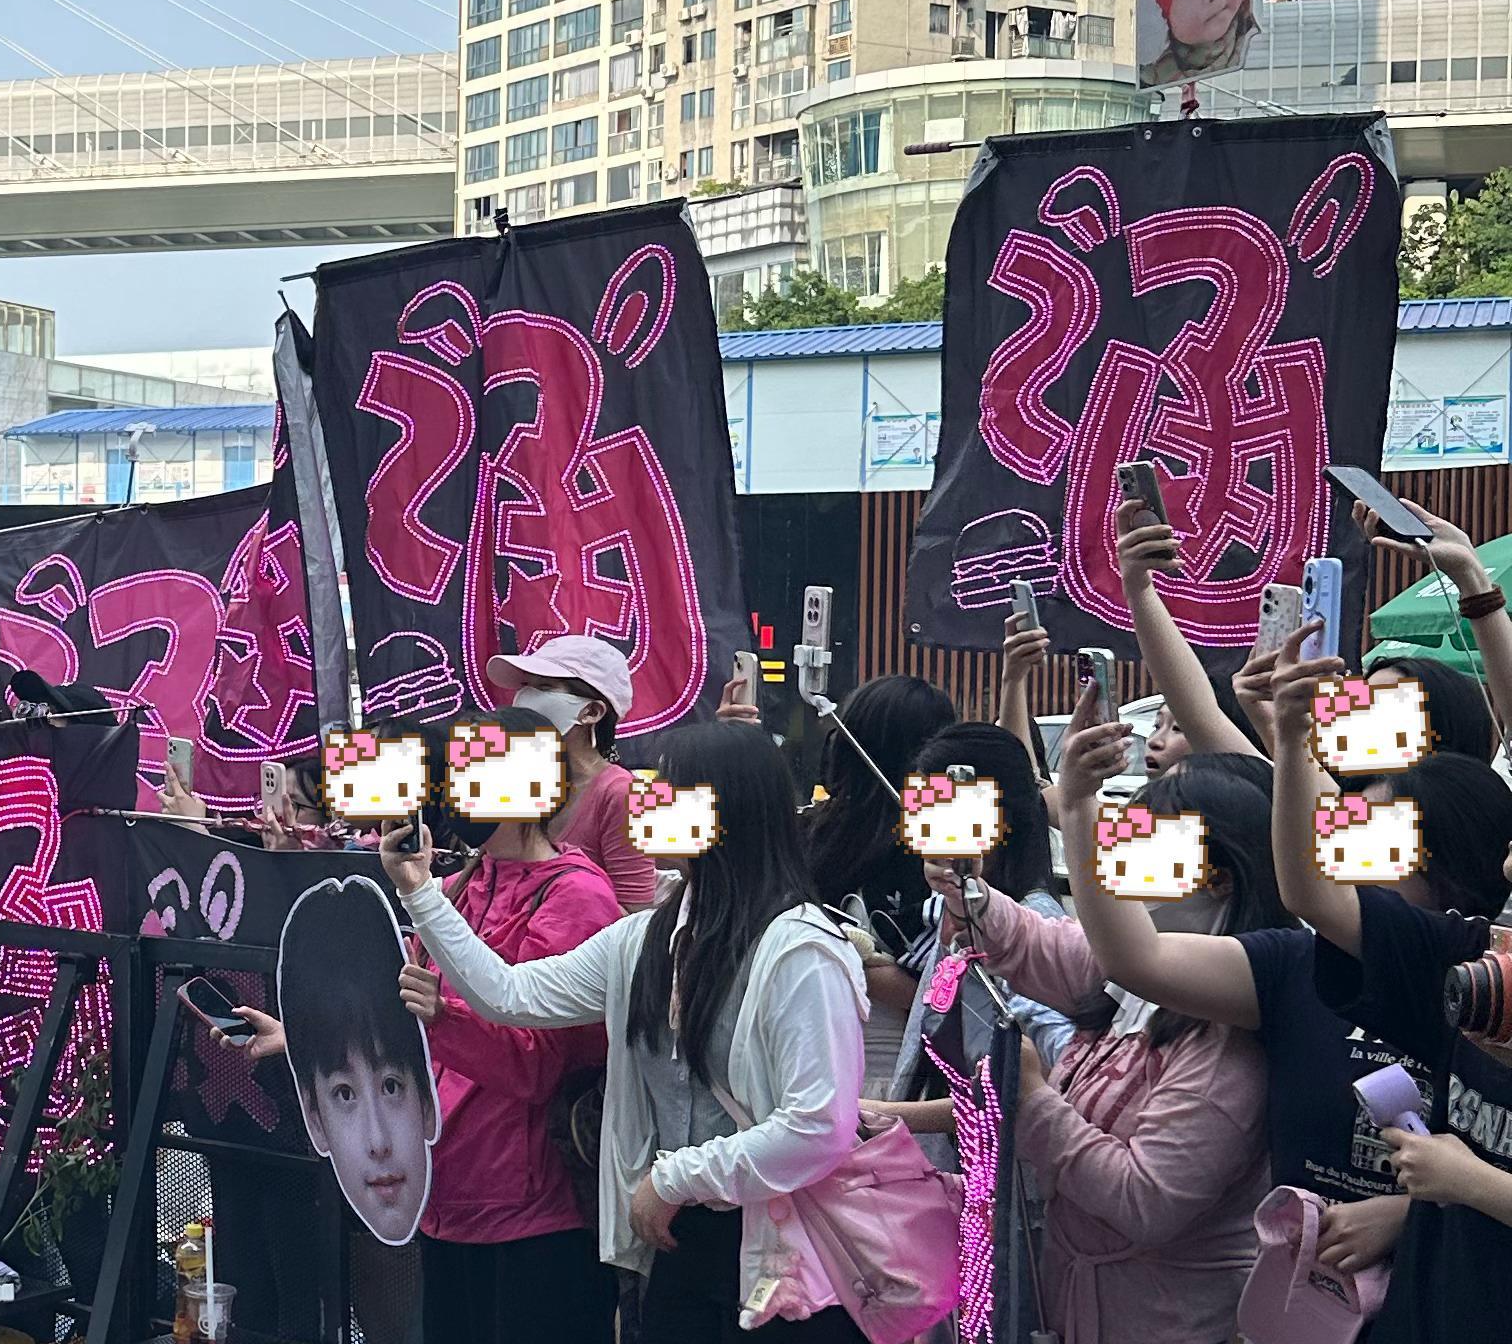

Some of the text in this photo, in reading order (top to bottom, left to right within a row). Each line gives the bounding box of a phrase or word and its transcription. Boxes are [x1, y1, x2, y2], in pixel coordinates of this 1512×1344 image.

[1350, 1046, 1364, 1059] la
[1367, 1051, 1397, 1064] ville
[1398, 1054, 1415, 1068] de
